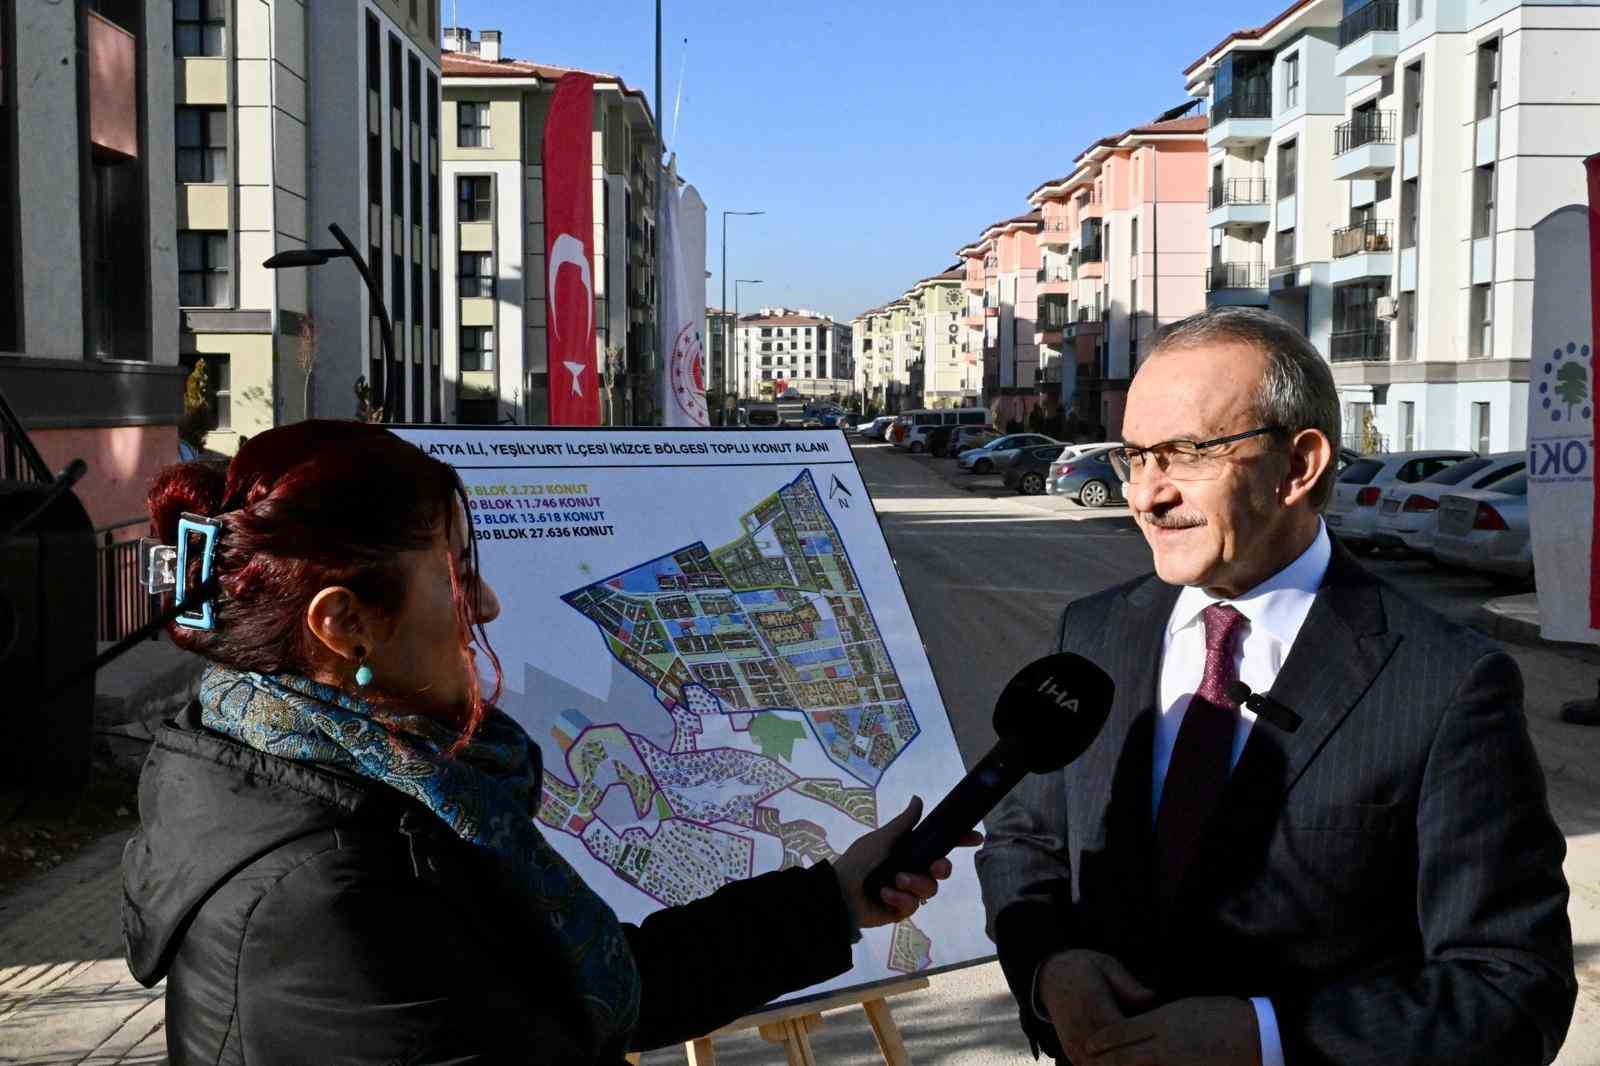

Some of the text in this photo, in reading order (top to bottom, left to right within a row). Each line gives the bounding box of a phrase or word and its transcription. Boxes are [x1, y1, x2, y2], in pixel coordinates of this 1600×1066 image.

[489, 442, 563, 457] YEŞİLYURT
[567, 441, 609, 457] İLÇESİ
[654, 441, 709, 455] BÖLGESİ
[710, 443, 750, 454] TOPLU
[752, 443, 792, 454] KONUT
[795, 442, 829, 453] ALANI
[474, 485, 508, 496] BLOK
[546, 484, 588, 495] KONUT
[479, 499, 514, 510] BLOK
[516, 498, 558, 509] 11.746
[559, 496, 601, 508] KONUT
[838, 497, 849, 510] N
[484, 513, 519, 525] BLOK
[520, 512, 562, 524] 13.618
[563, 511, 605, 523] KONUT
[493, 528, 528, 540] BLOK
[529, 527, 571, 539] 27.636
[572, 525, 615, 537] KONUT
